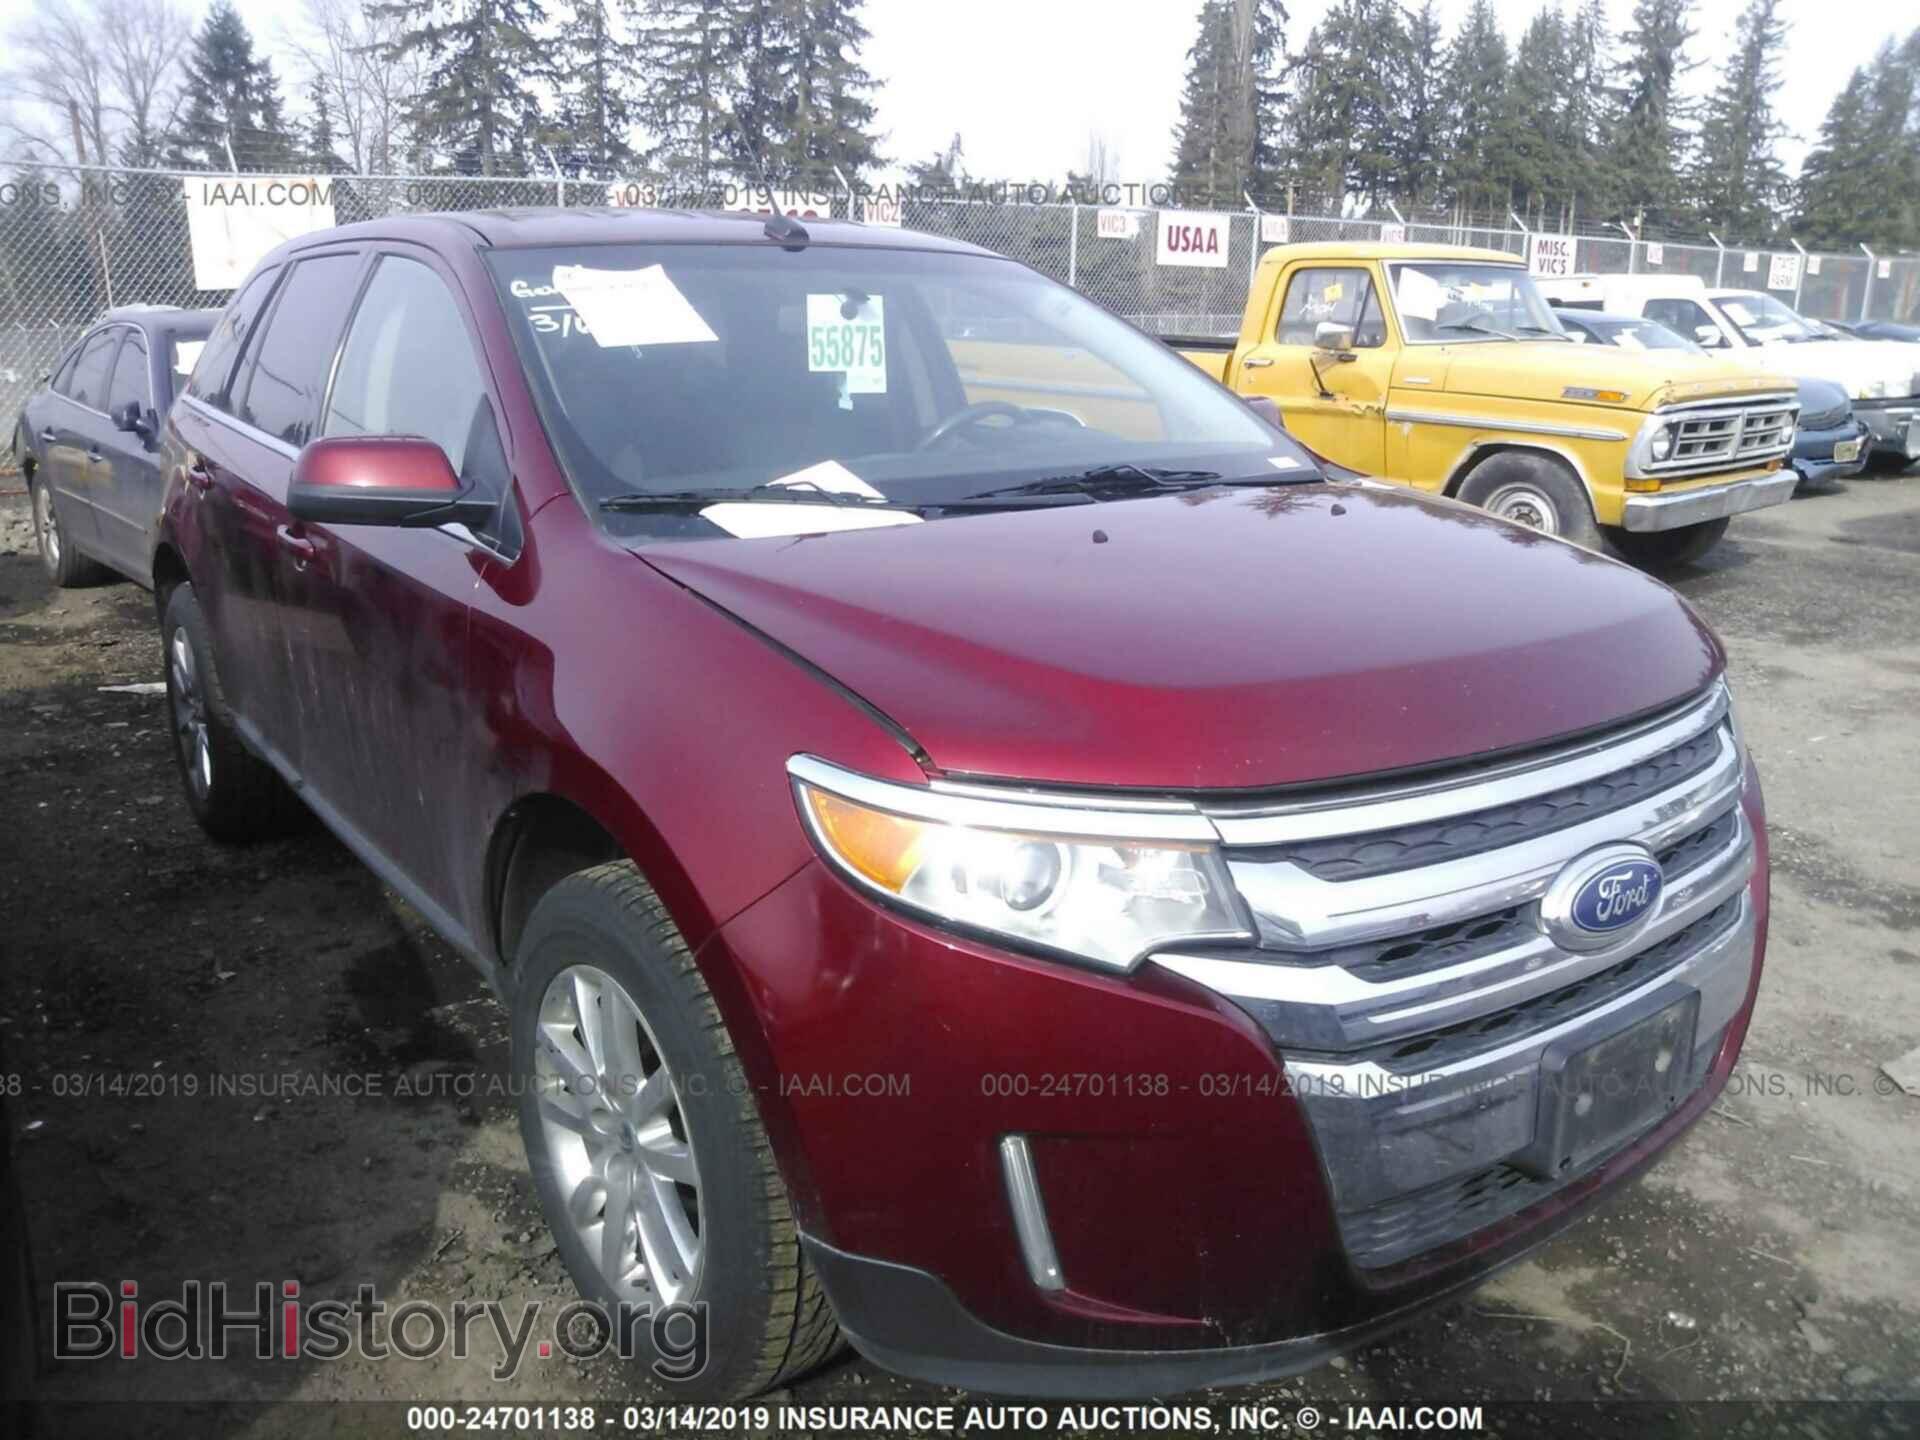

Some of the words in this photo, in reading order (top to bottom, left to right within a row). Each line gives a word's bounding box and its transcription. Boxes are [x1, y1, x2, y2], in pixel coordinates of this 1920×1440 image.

[1100, 215, 1126, 233] VIC3
[1167, 225, 1218, 253] USAA
[1537, 239, 1570, 257] MISC.
[811, 325, 883, 367] 55875
[1596, 870, 1650, 922] Ford
